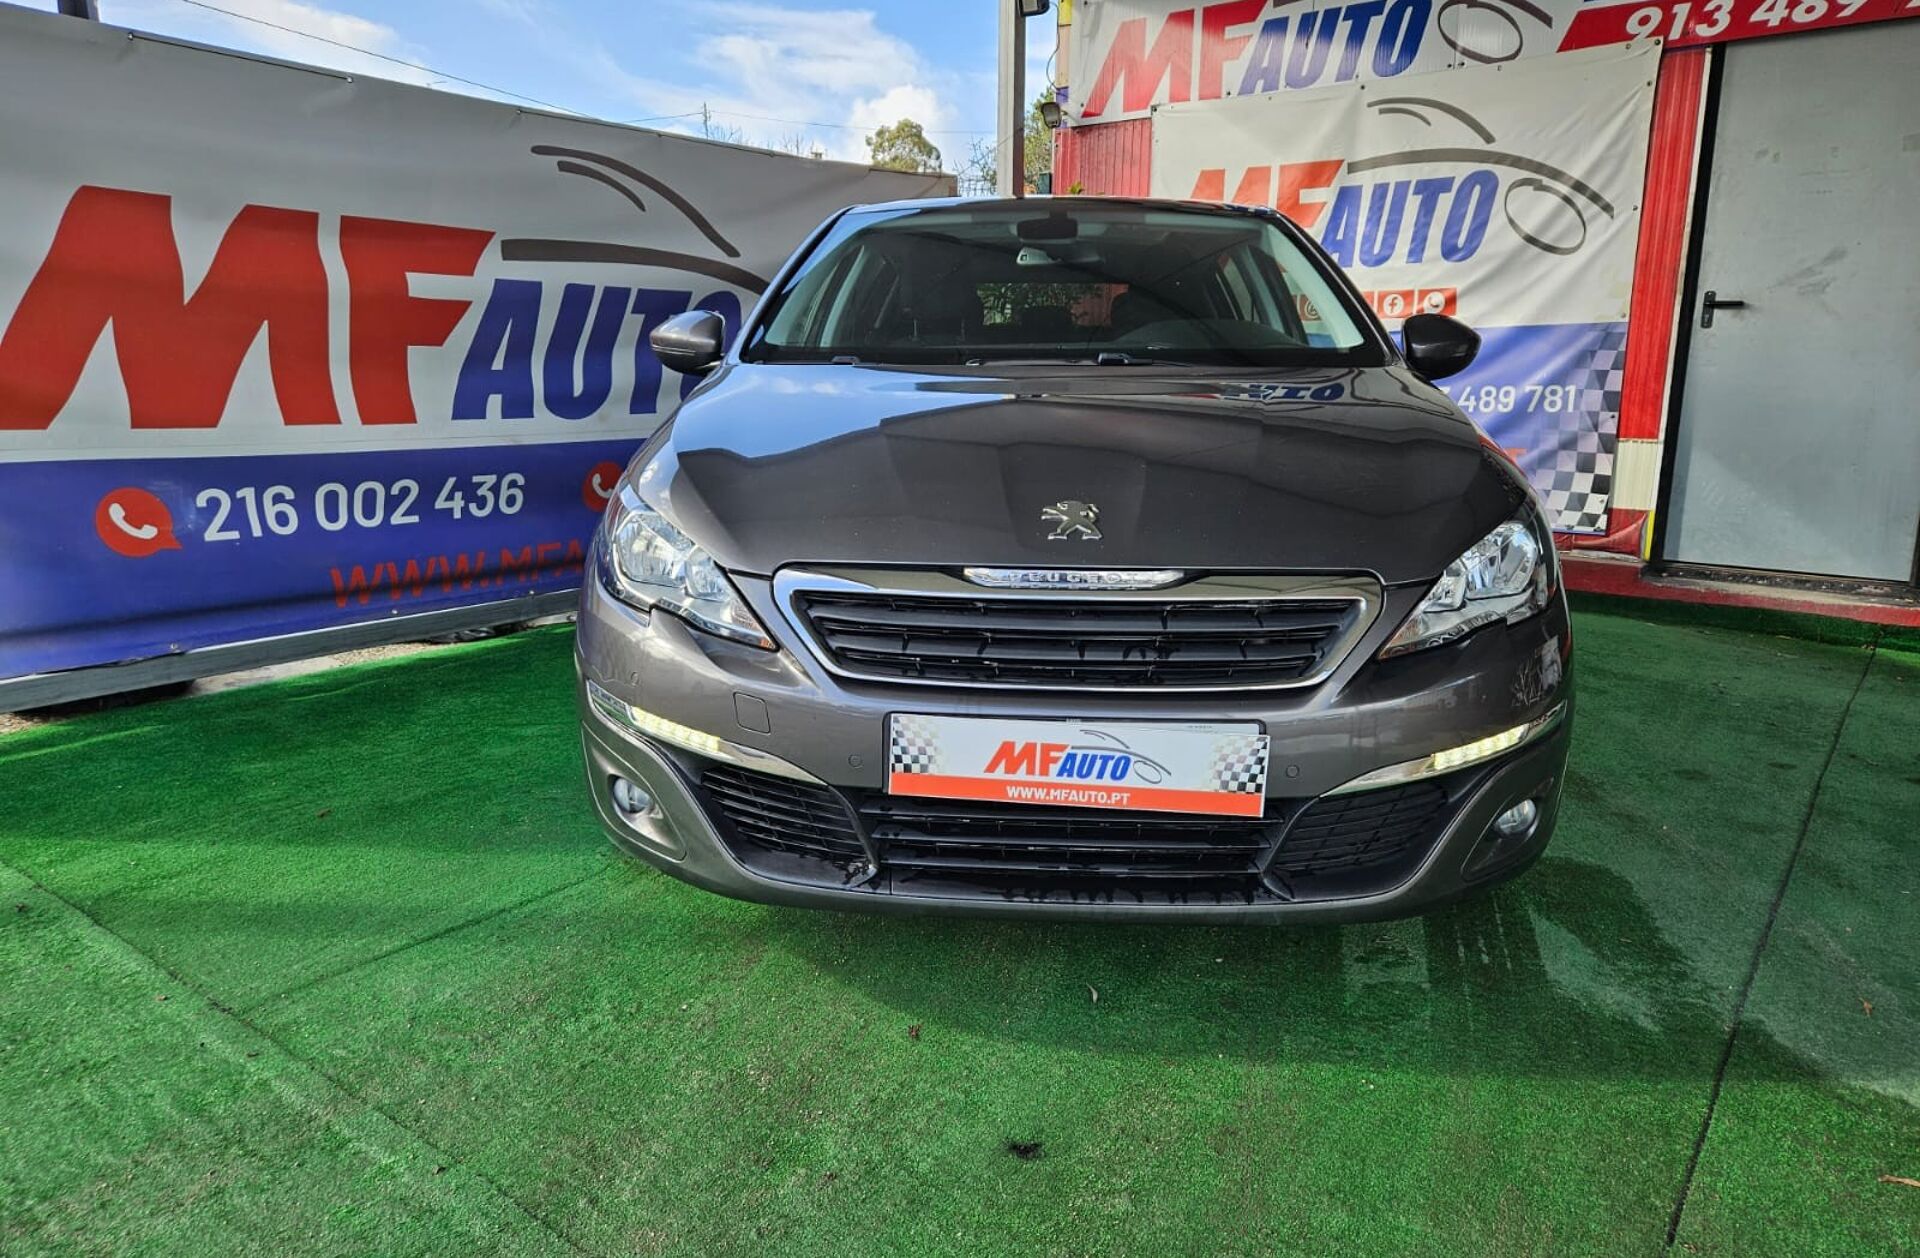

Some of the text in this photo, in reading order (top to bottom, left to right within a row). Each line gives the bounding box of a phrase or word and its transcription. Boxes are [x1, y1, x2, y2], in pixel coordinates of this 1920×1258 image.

[1625, 0, 1731, 41] 913
[1458, 384, 1577, 413] 489 781
[196, 472, 526, 542] 216 002 436
[1006, 785, 1131, 806] WWW.MFAUTO.PT
